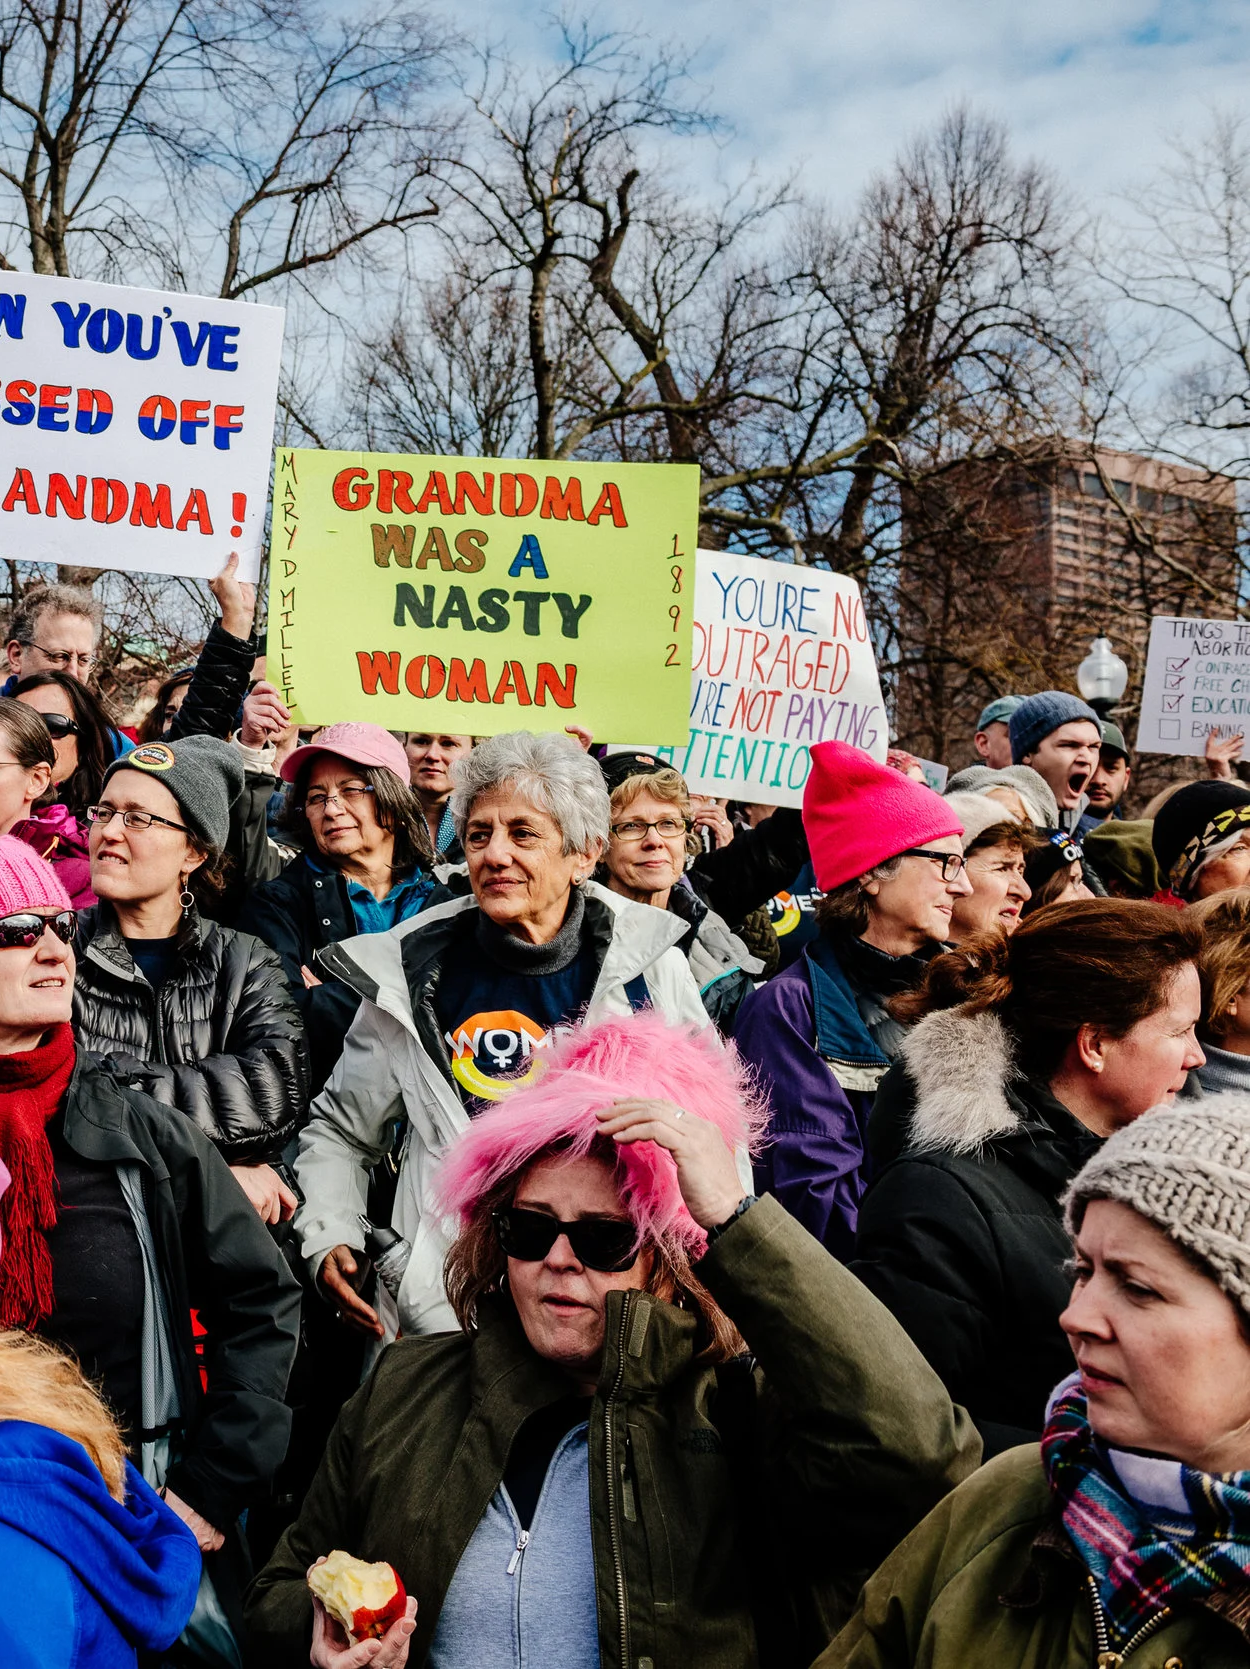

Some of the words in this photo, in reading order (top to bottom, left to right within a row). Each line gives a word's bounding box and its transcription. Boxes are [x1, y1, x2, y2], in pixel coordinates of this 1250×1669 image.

[50, 301, 241, 372] YOU'VE
[137, 394, 245, 451] OFF
[281, 452, 299, 550] MARY
[332, 467, 629, 528] GRANDMA
[370, 524, 489, 574] WAS
[508, 534, 549, 579] A
[394, 582, 593, 639] NASTY
[712, 571, 820, 634] YOU'RE
[833, 592, 867, 642] NO
[1165, 620, 1223, 639] THINGS
[1234, 624, 1250, 641] TH
[1191, 640, 1250, 656] ABORTIO
[356, 650, 577, 709] WOMAN
[1193, 675, 1224, 692] FREE
[1230, 679, 1250, 693] CH
[729, 687, 783, 734] NOT
[783, 693, 880, 750] PAYING
